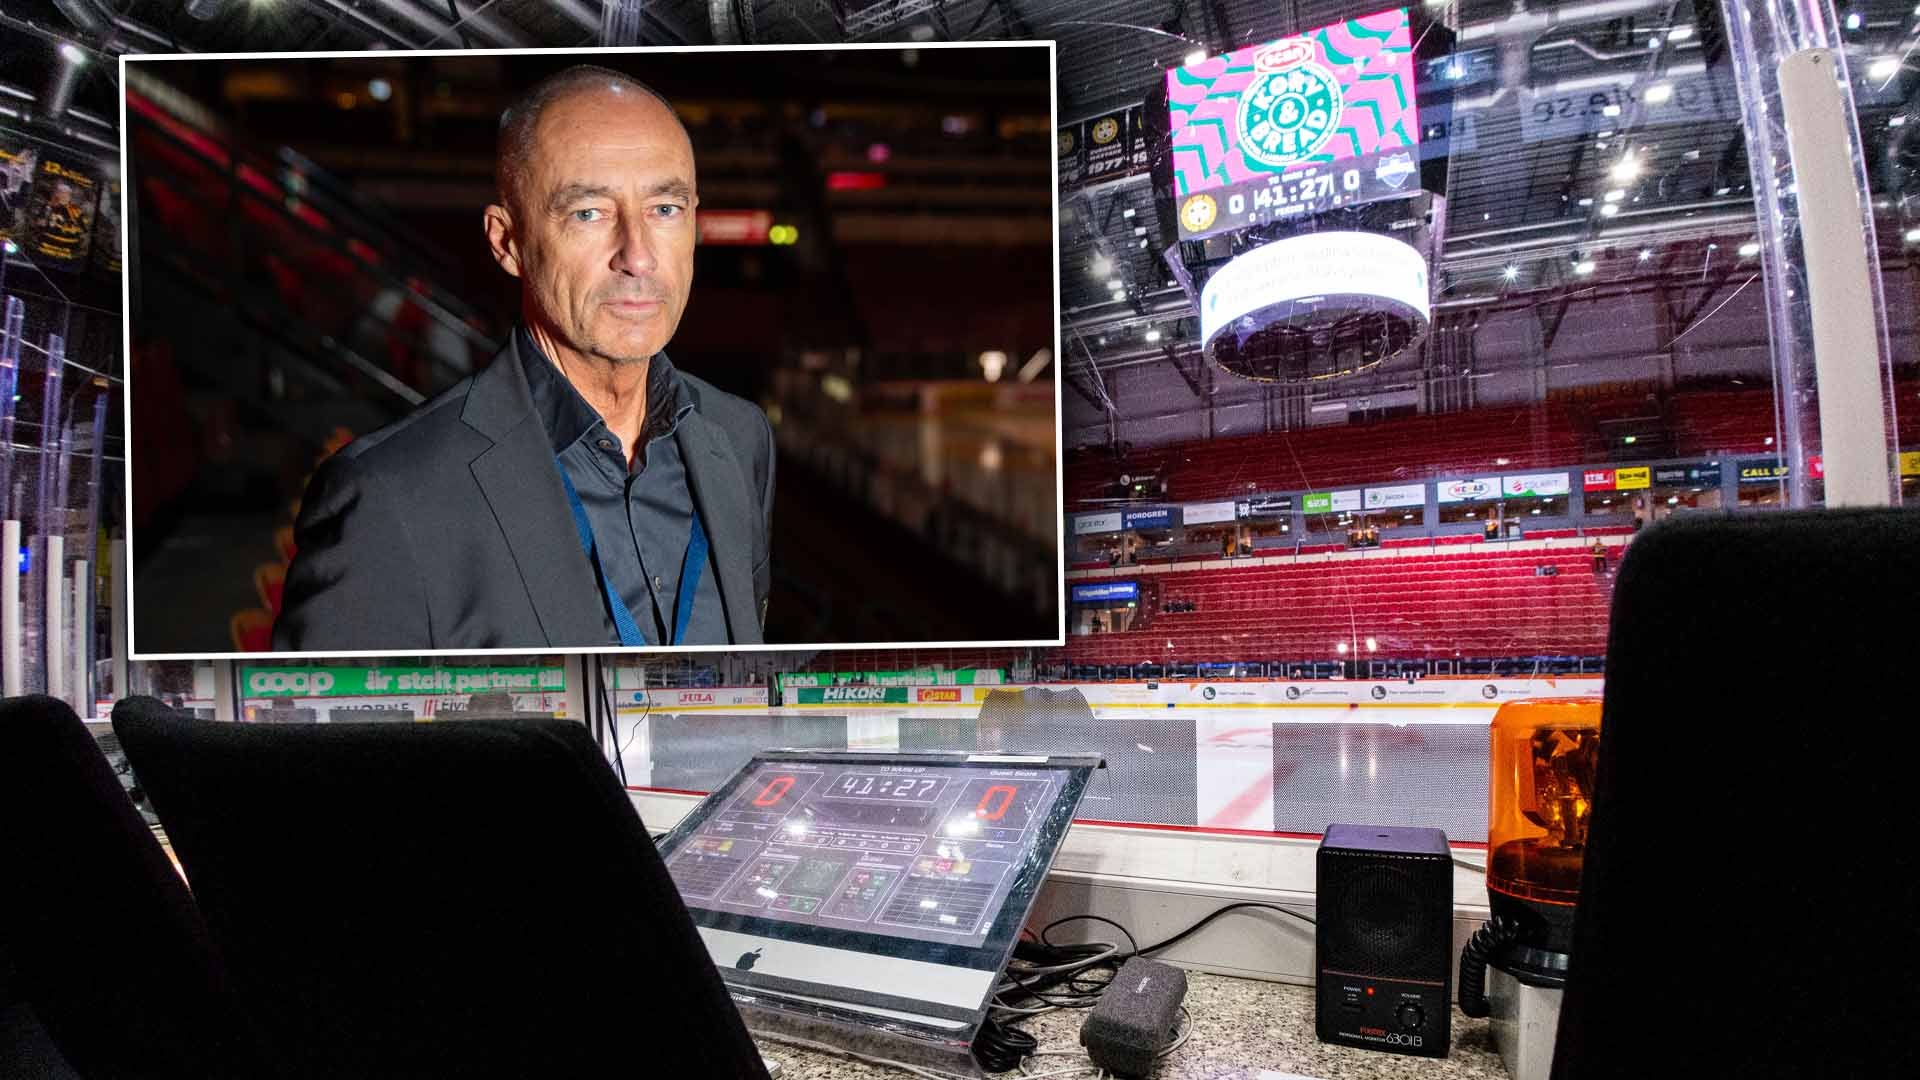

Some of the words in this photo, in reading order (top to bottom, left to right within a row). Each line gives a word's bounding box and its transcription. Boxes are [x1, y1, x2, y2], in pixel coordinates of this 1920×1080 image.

[1278, 101, 1299, 125] &
[1249, 108, 1328, 153] BREAD
[1088, 156, 1124, 175] 1977
[1229, 194, 1244, 214] 0
[1343, 169, 1360, 191] 0
[1741, 468, 1770, 477] CALL
[1126, 510, 1168, 521] NORDGREN
[250, 672, 334, 696] coop
[365, 670, 393, 691] är
[397, 670, 452, 689] stolt
[455, 670, 537, 693] partner
[538, 669, 564, 688] till
[680, 693, 713, 703] JULA
[752, 776, 797, 807] 0
[842, 776, 937, 798] 41:27
[975, 785, 1018, 822] 0
[1385, 1032, 1423, 1047] 6301B
